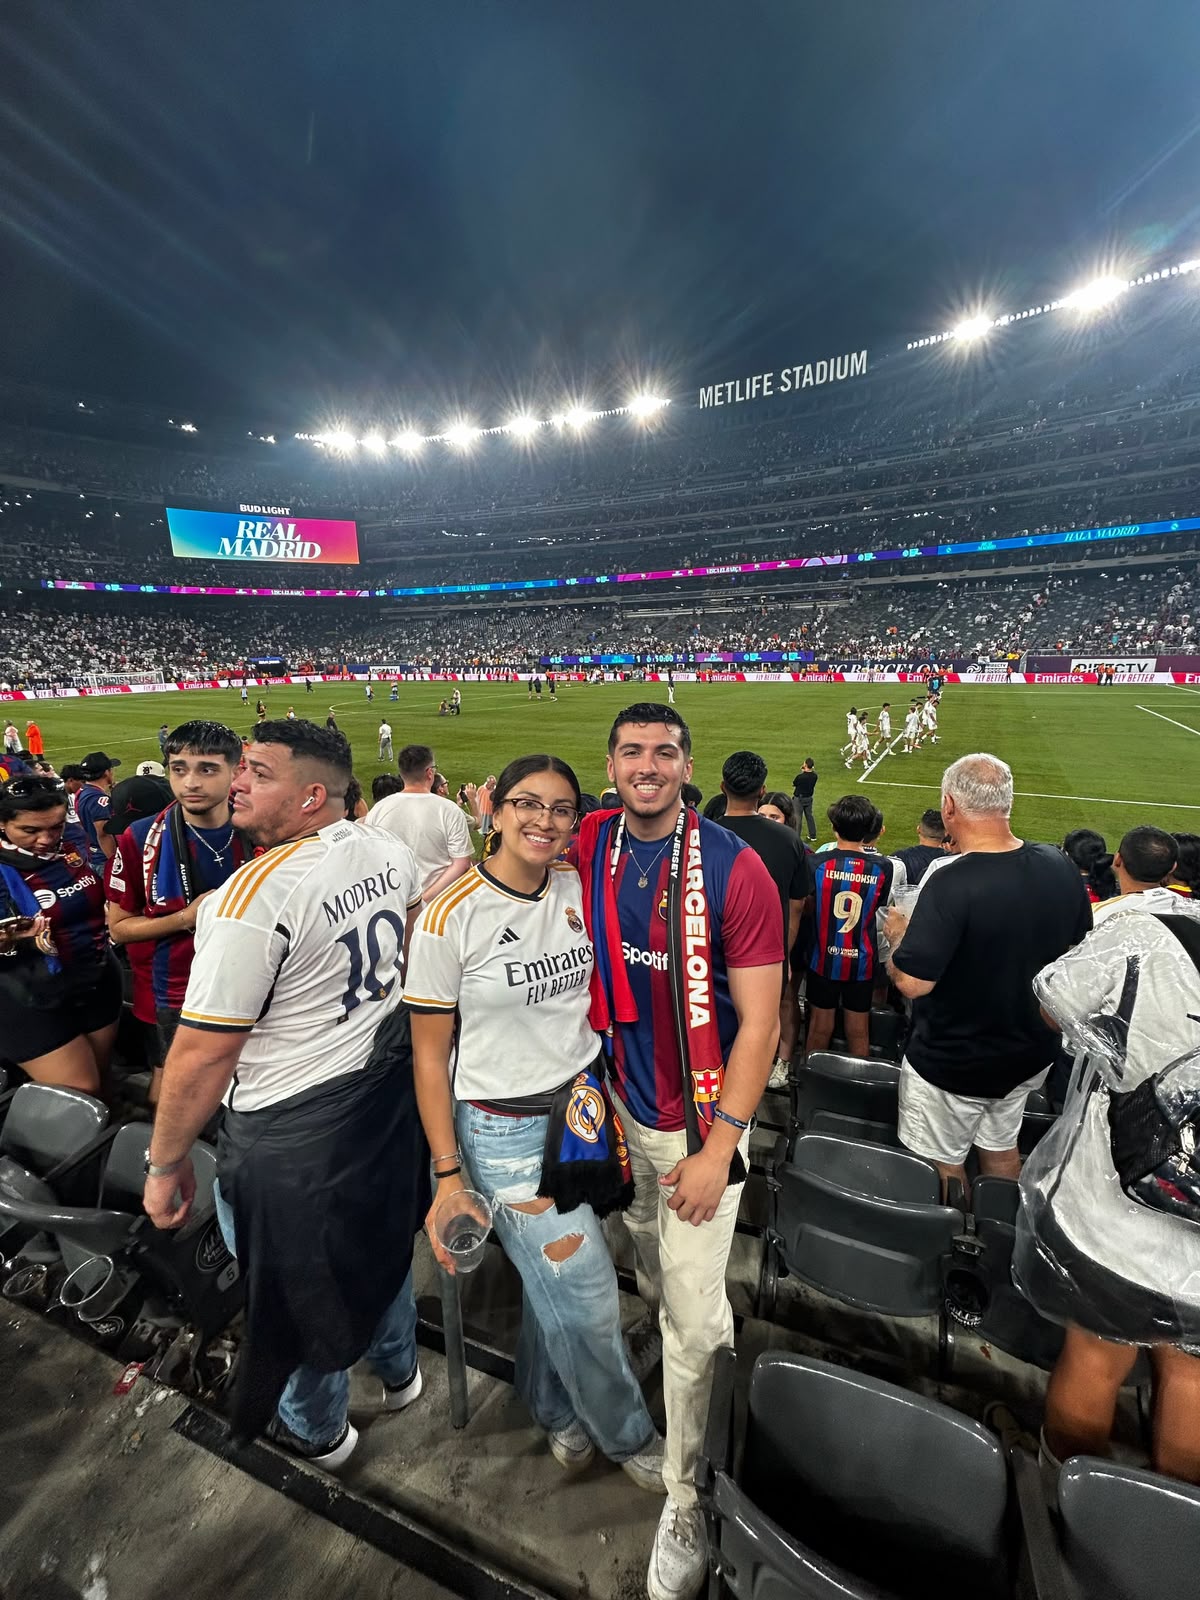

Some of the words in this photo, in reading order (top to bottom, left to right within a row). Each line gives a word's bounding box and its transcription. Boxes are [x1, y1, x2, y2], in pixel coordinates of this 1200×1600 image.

[700, 372, 774, 409] METLIFE
[780, 350, 868, 392] STADIUM
[239, 504, 261, 513] BUD
[262, 505, 291, 515] LIGHT
[236, 520, 301, 542] REAL
[1064, 531, 1092, 543] HALA
[1095, 526, 1140, 538] MADRID
[217, 537, 322, 560] MADRID
[1034, 673, 1084, 683] Emirates
[1114, 674, 1126, 682] FLY
[1127, 673, 1155, 682] BETTER
[675, 812, 685, 835] NEW
[670, 836, 682, 879] JERSEY
[56, 875, 97, 898] Spotify
[825, 869, 878, 885] LEWANDOWSKI
[322, 862, 401, 927] MODRIĆ
[833, 890, 863, 933] 9
[684, 828, 711, 1029] BARCELONA
[335, 909, 405, 1018] 10
[504, 944, 593, 987] Emirates
[622, 942, 669, 971] Spotif
[526, 982, 547, 1006] FLY
[550, 968, 587, 998] BETTER
[226, 1268, 235, 1281] 5
